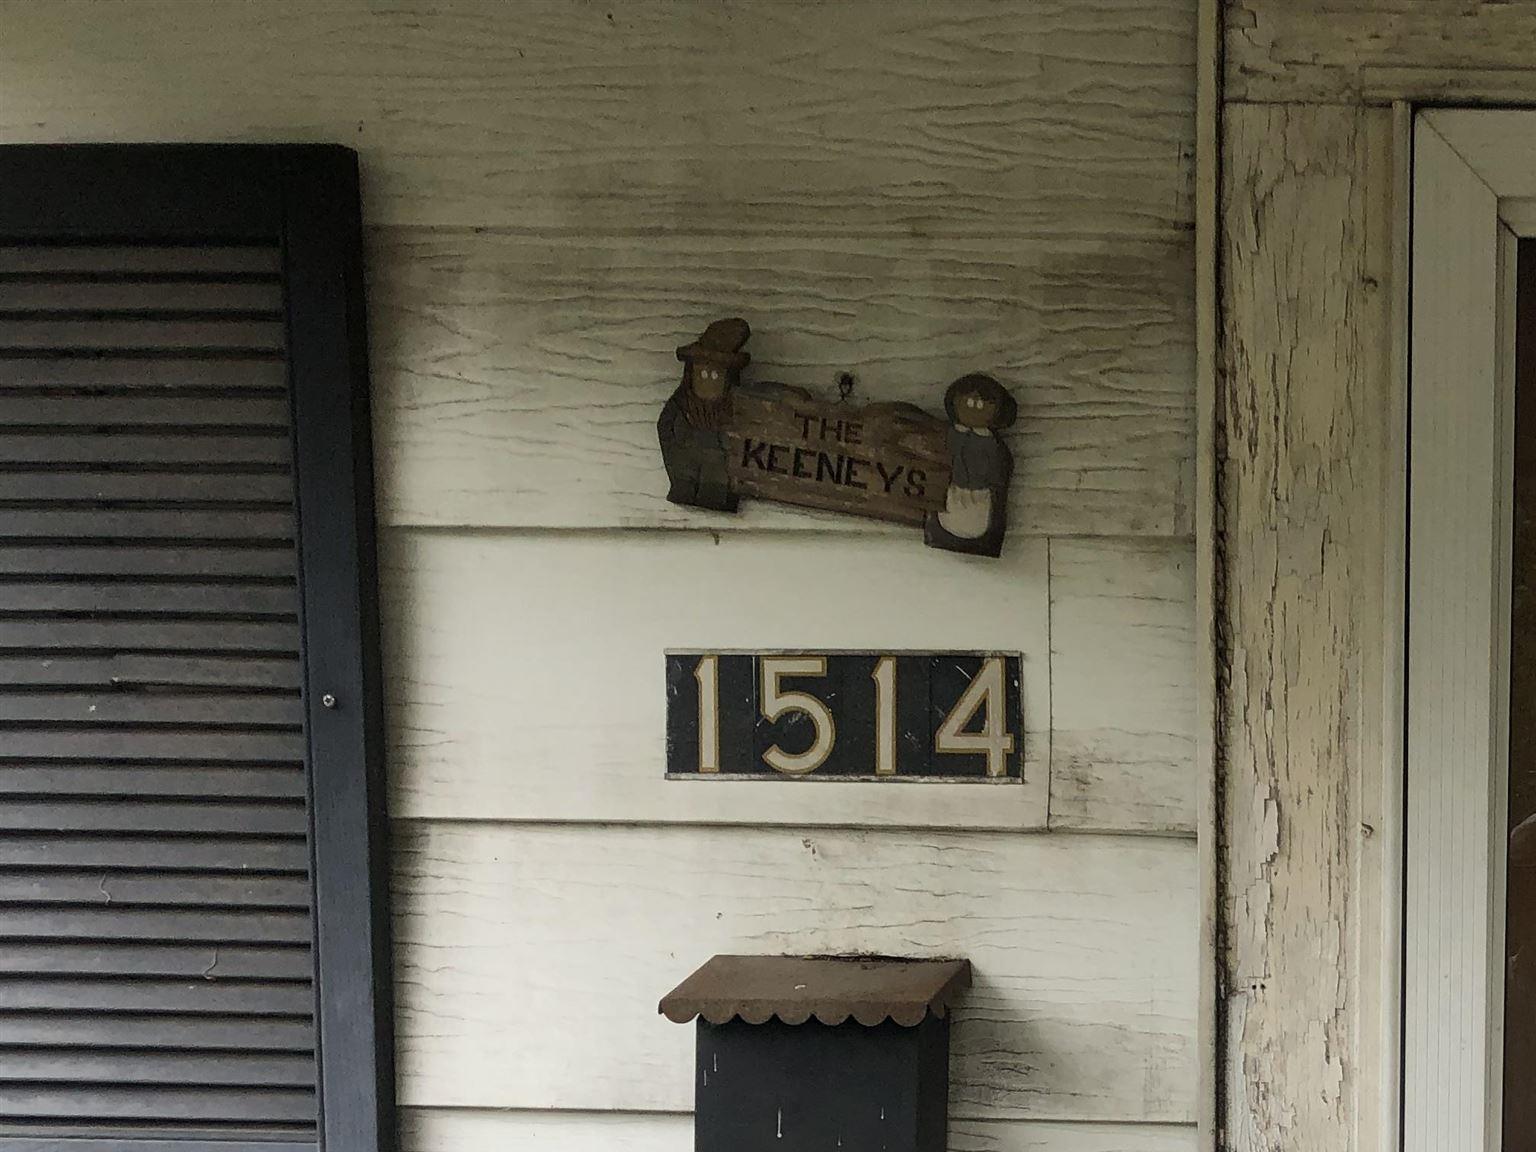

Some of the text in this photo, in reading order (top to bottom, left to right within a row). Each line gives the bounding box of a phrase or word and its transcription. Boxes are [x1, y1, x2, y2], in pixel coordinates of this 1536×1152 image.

[793, 413, 865, 445] THE
[740, 437, 928, 498] KEENEYS
[693, 654, 1015, 776] 1514
